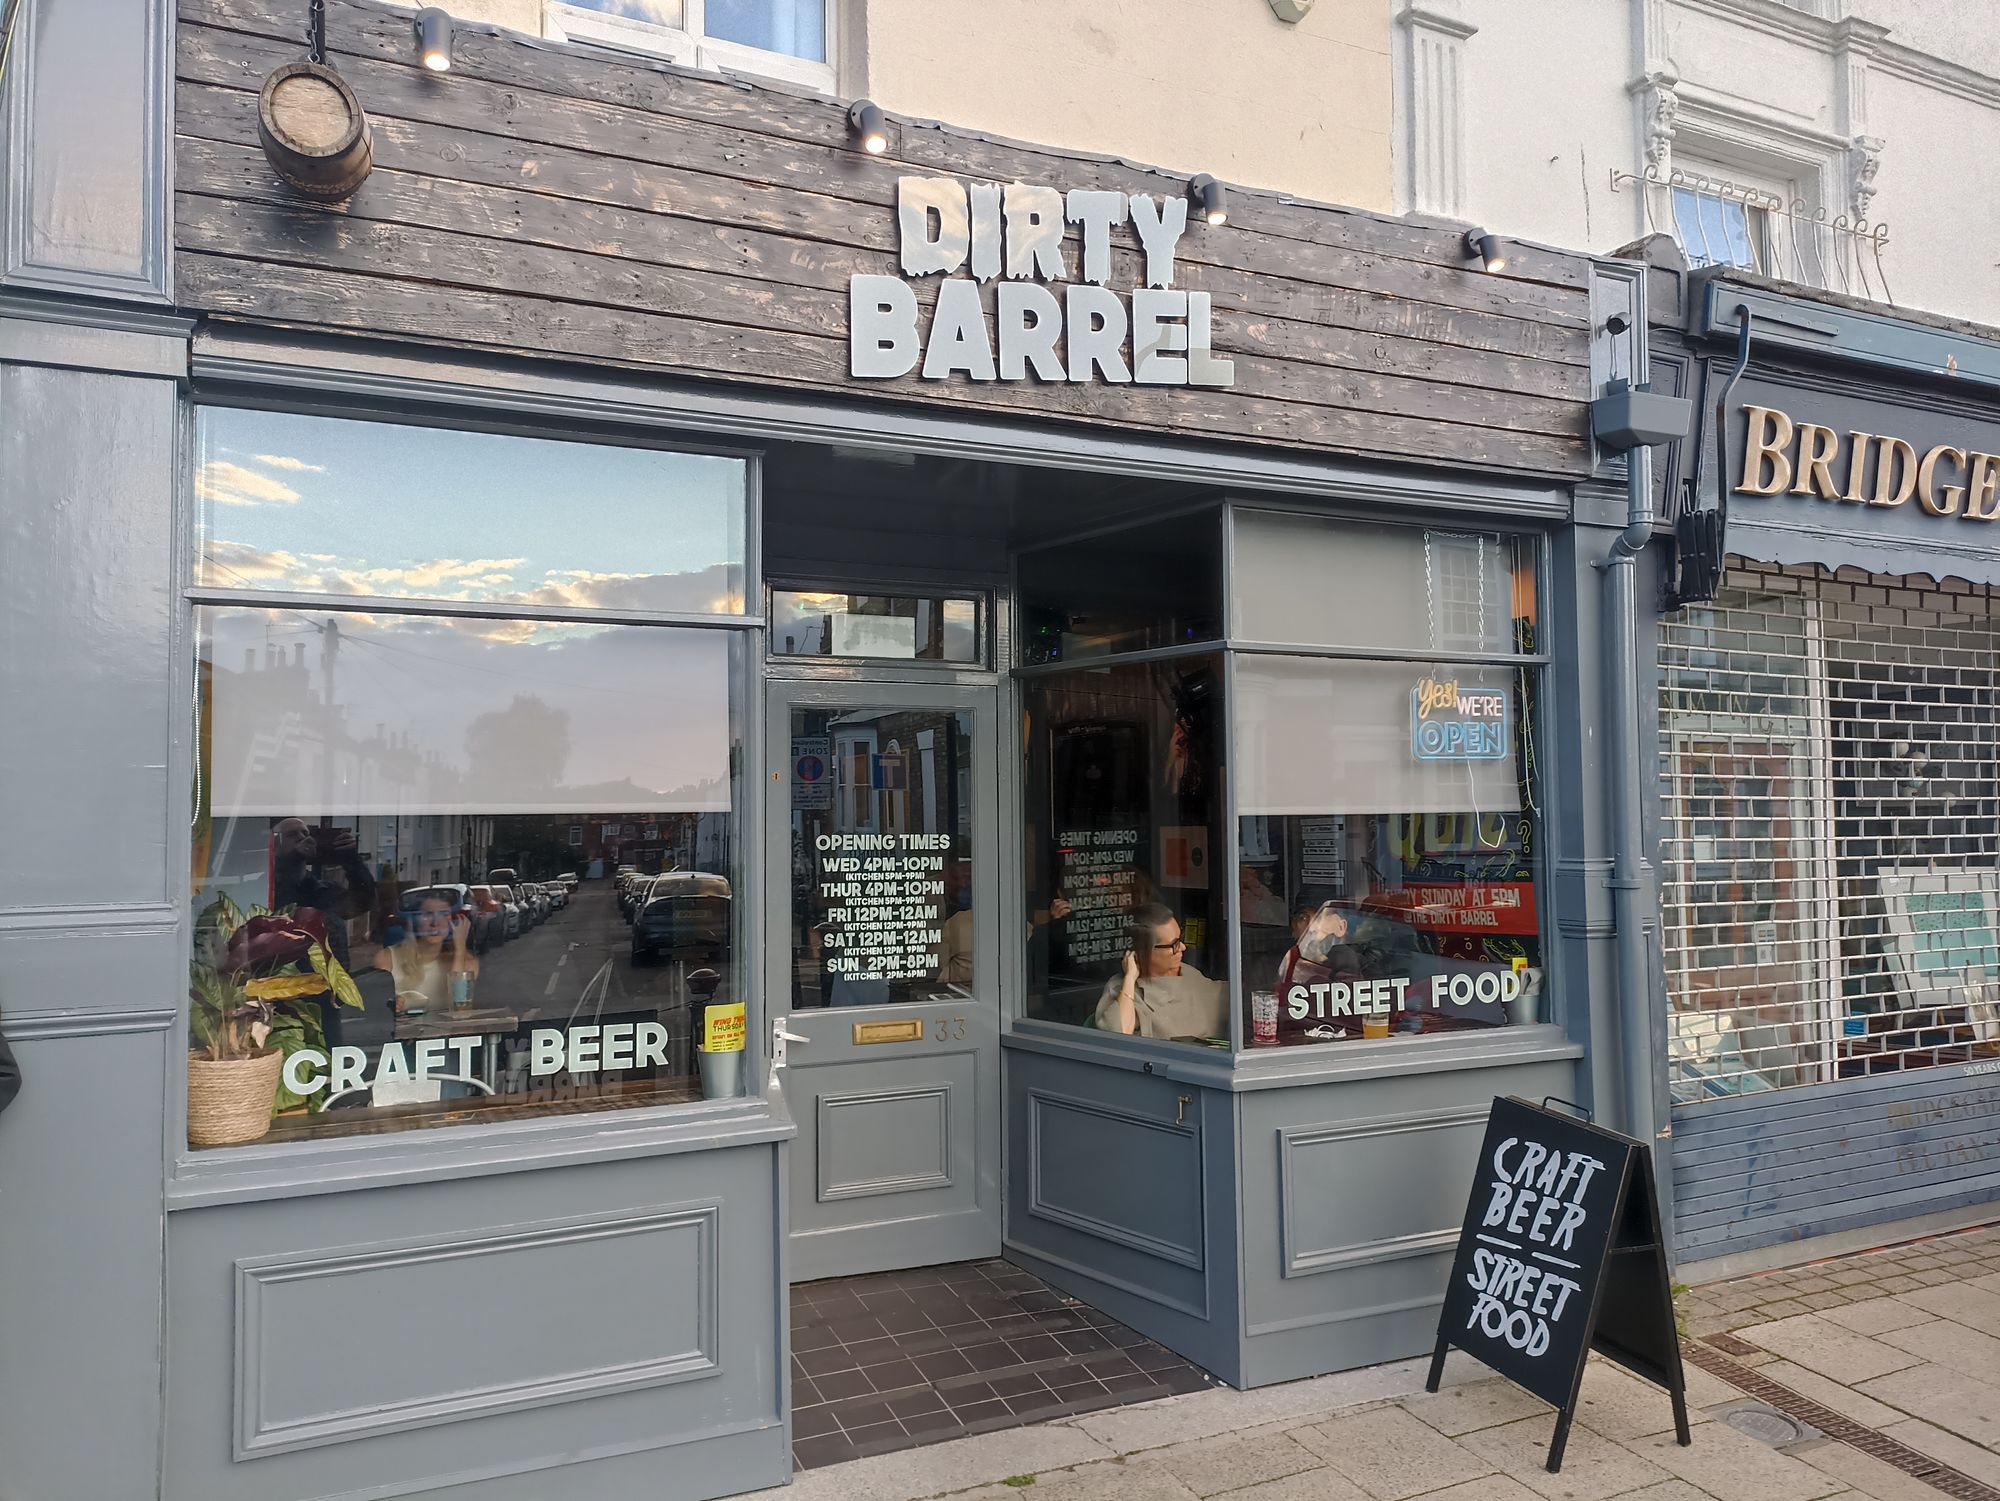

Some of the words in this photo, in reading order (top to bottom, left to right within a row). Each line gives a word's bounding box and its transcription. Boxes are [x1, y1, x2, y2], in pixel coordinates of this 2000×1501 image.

[898, 175, 1189, 291] DIRTY
[850, 273, 1235, 386] BARREL
[1734, 403, 2000, 521] BRIDGE
[1456, 696, 1502, 717] WE'RE
[1418, 720, 1501, 754] OPEN
[815, 834, 896, 851] OPENING
[899, 833, 951, 850] TIMES
[822, 858, 861, 872] WED
[863, 856, 943, 872] 4PM-10PM
[845, 873, 884, 881] (KITCHEN
[884, 872, 925, 880] 5PM-9PM)
[820, 882, 861, 897] THUR
[865, 880, 945, 896] 4PM-10PM
[1421, 888, 1466, 907] SUNDAY
[1472, 888, 1486, 907] AT
[1491, 888, 1521, 907] 5PM
[845, 897, 884, 906] (KITCHEN
[884, 897, 925, 905] 5PM-9PM)
[827, 908, 852, 923] FRI
[855, 905, 938, 921] 12PM-12AM
[1430, 910, 1457, 925] DIRTY
[1461, 910, 1499, 926] BARREL
[844, 922, 882, 931] (KITCHEN
[883, 921, 926, 930] 12PM-9PM)
[823, 932, 856, 948] SAT
[858, 929, 942, 946] 12PM-12AM
[844, 947, 882, 956] (KITCHEN
[827, 957, 860, 973] SUN
[867, 954, 939, 971] 2PM-8PM
[844, 972, 882, 981] (KITCHEN
[886, 970, 926, 979] 2PM-6PM)
[1287, 977, 1410, 1020] STREET
[1431, 970, 1521, 1009] FOOD
[935, 1017, 965, 1042] 33
[282, 1035, 483, 1096] CRAFT
[530, 1022, 669, 1076] BEER
[1493, 1137, 1606, 1205] CRAFT
[1482, 1182, 1587, 1251] BEER
[1466, 1247, 1582, 1322] STREET
[1466, 1292, 1550, 1357] FOOD
